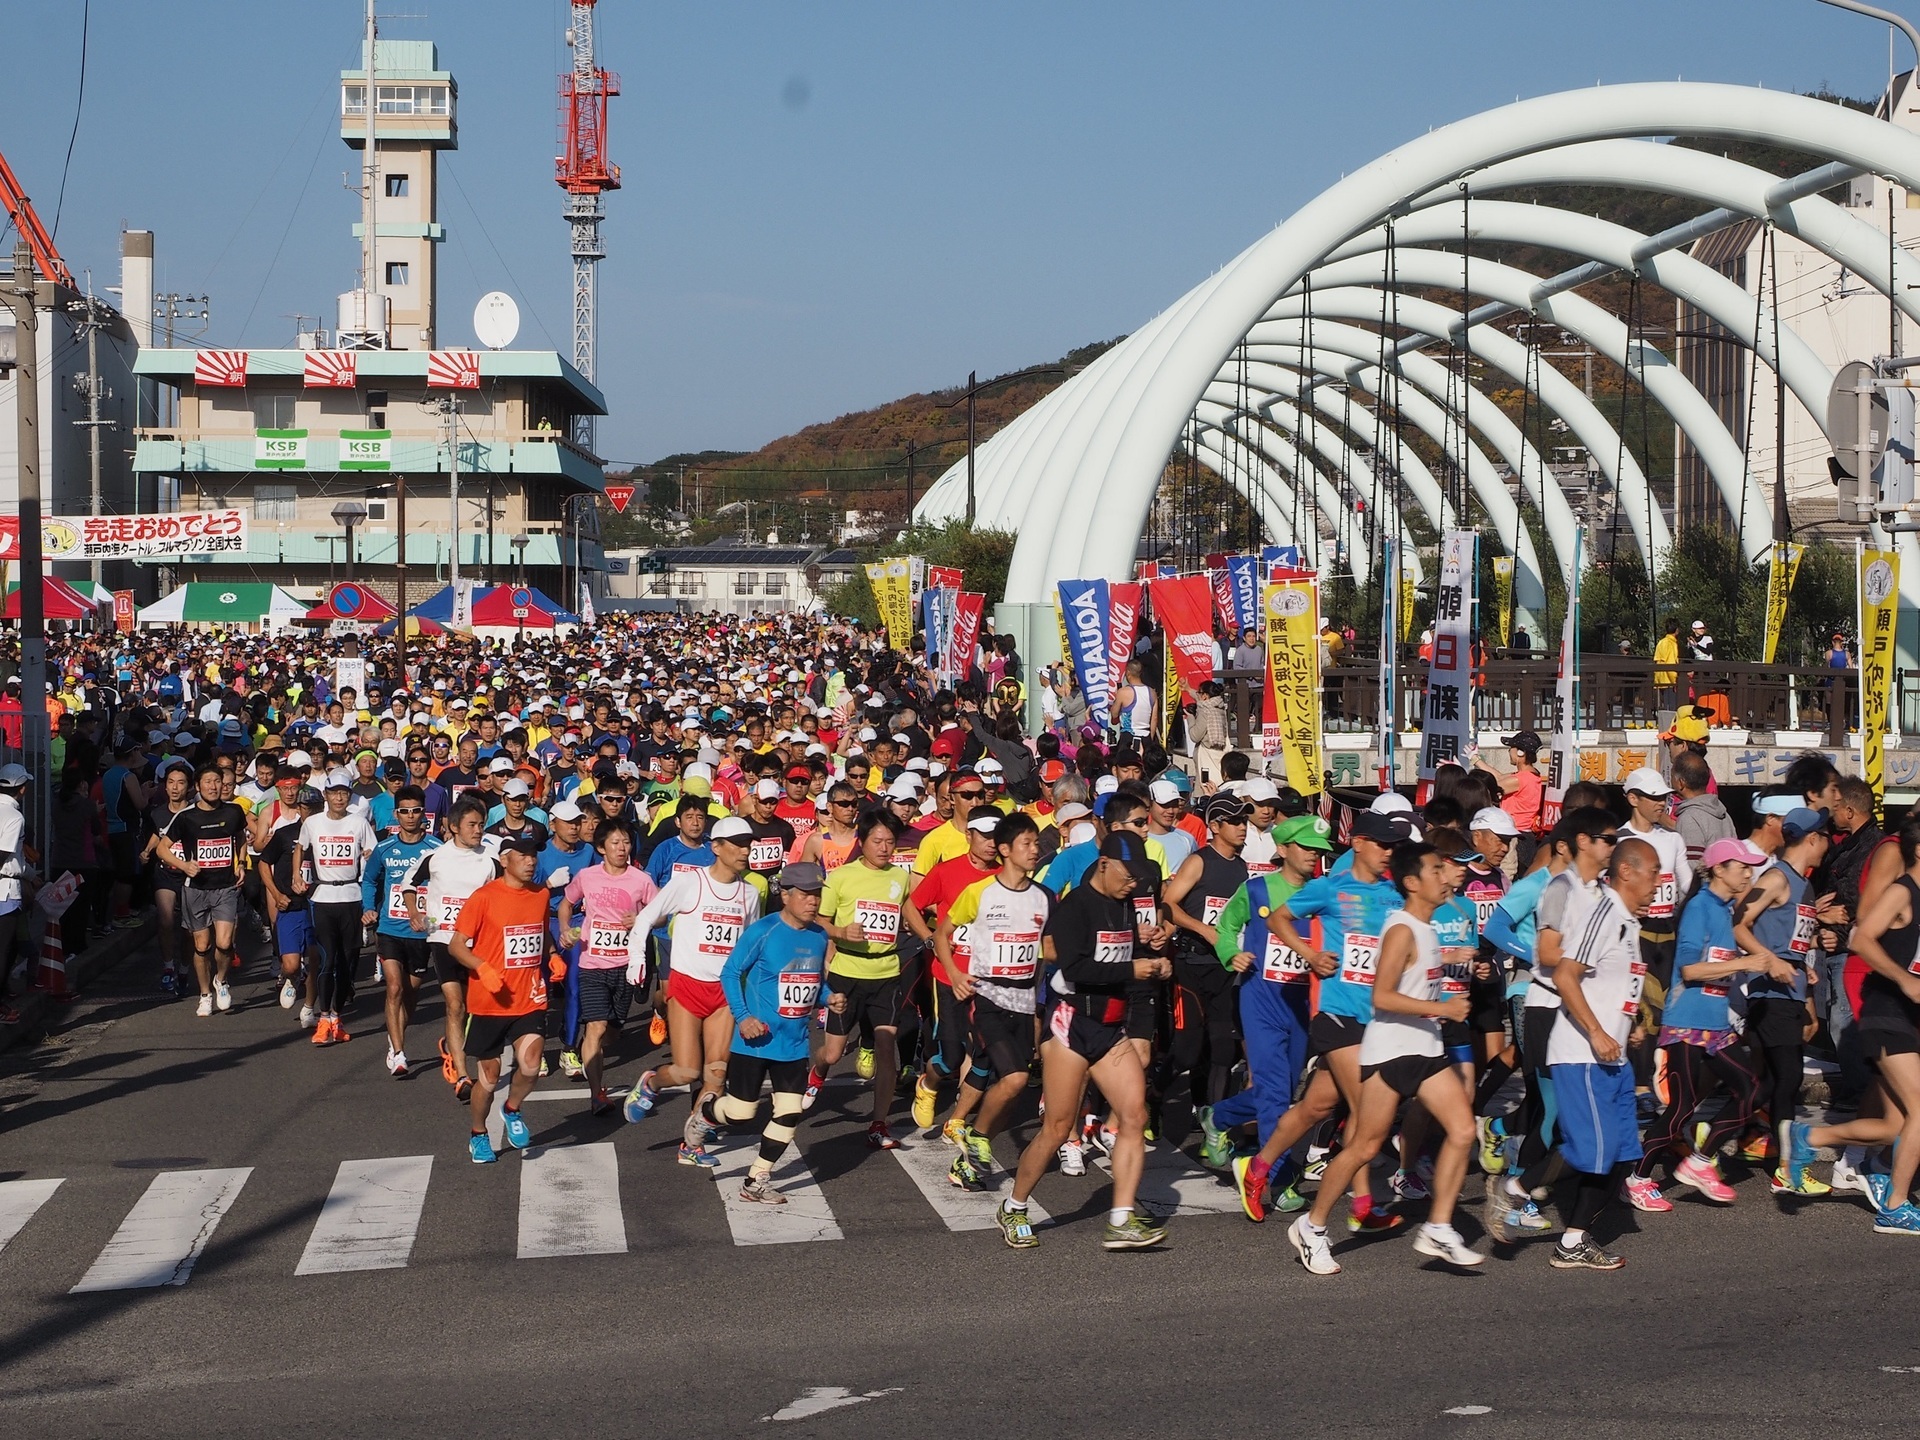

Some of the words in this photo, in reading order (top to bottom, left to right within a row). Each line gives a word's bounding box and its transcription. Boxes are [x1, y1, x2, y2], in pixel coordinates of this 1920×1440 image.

[266, 441, 297, 451] KSB
[349, 442, 381, 452] KSB
[84, 511, 242, 543] 完走おめでとう
[198, 846, 231, 859] 20002
[320, 844, 352, 857] 3129
[751, 846, 780, 860] 3123
[385, 858, 418, 867] MoveS
[589, 893, 617, 901] NORTH
[860, 911, 896, 931] 2293
[595, 931, 629, 947] 2346
[705, 924, 740, 944] 3341
[509, 935, 542, 955] 2359
[999, 944, 1034, 963] 1120
[784, 985, 818, 1004] 4023
